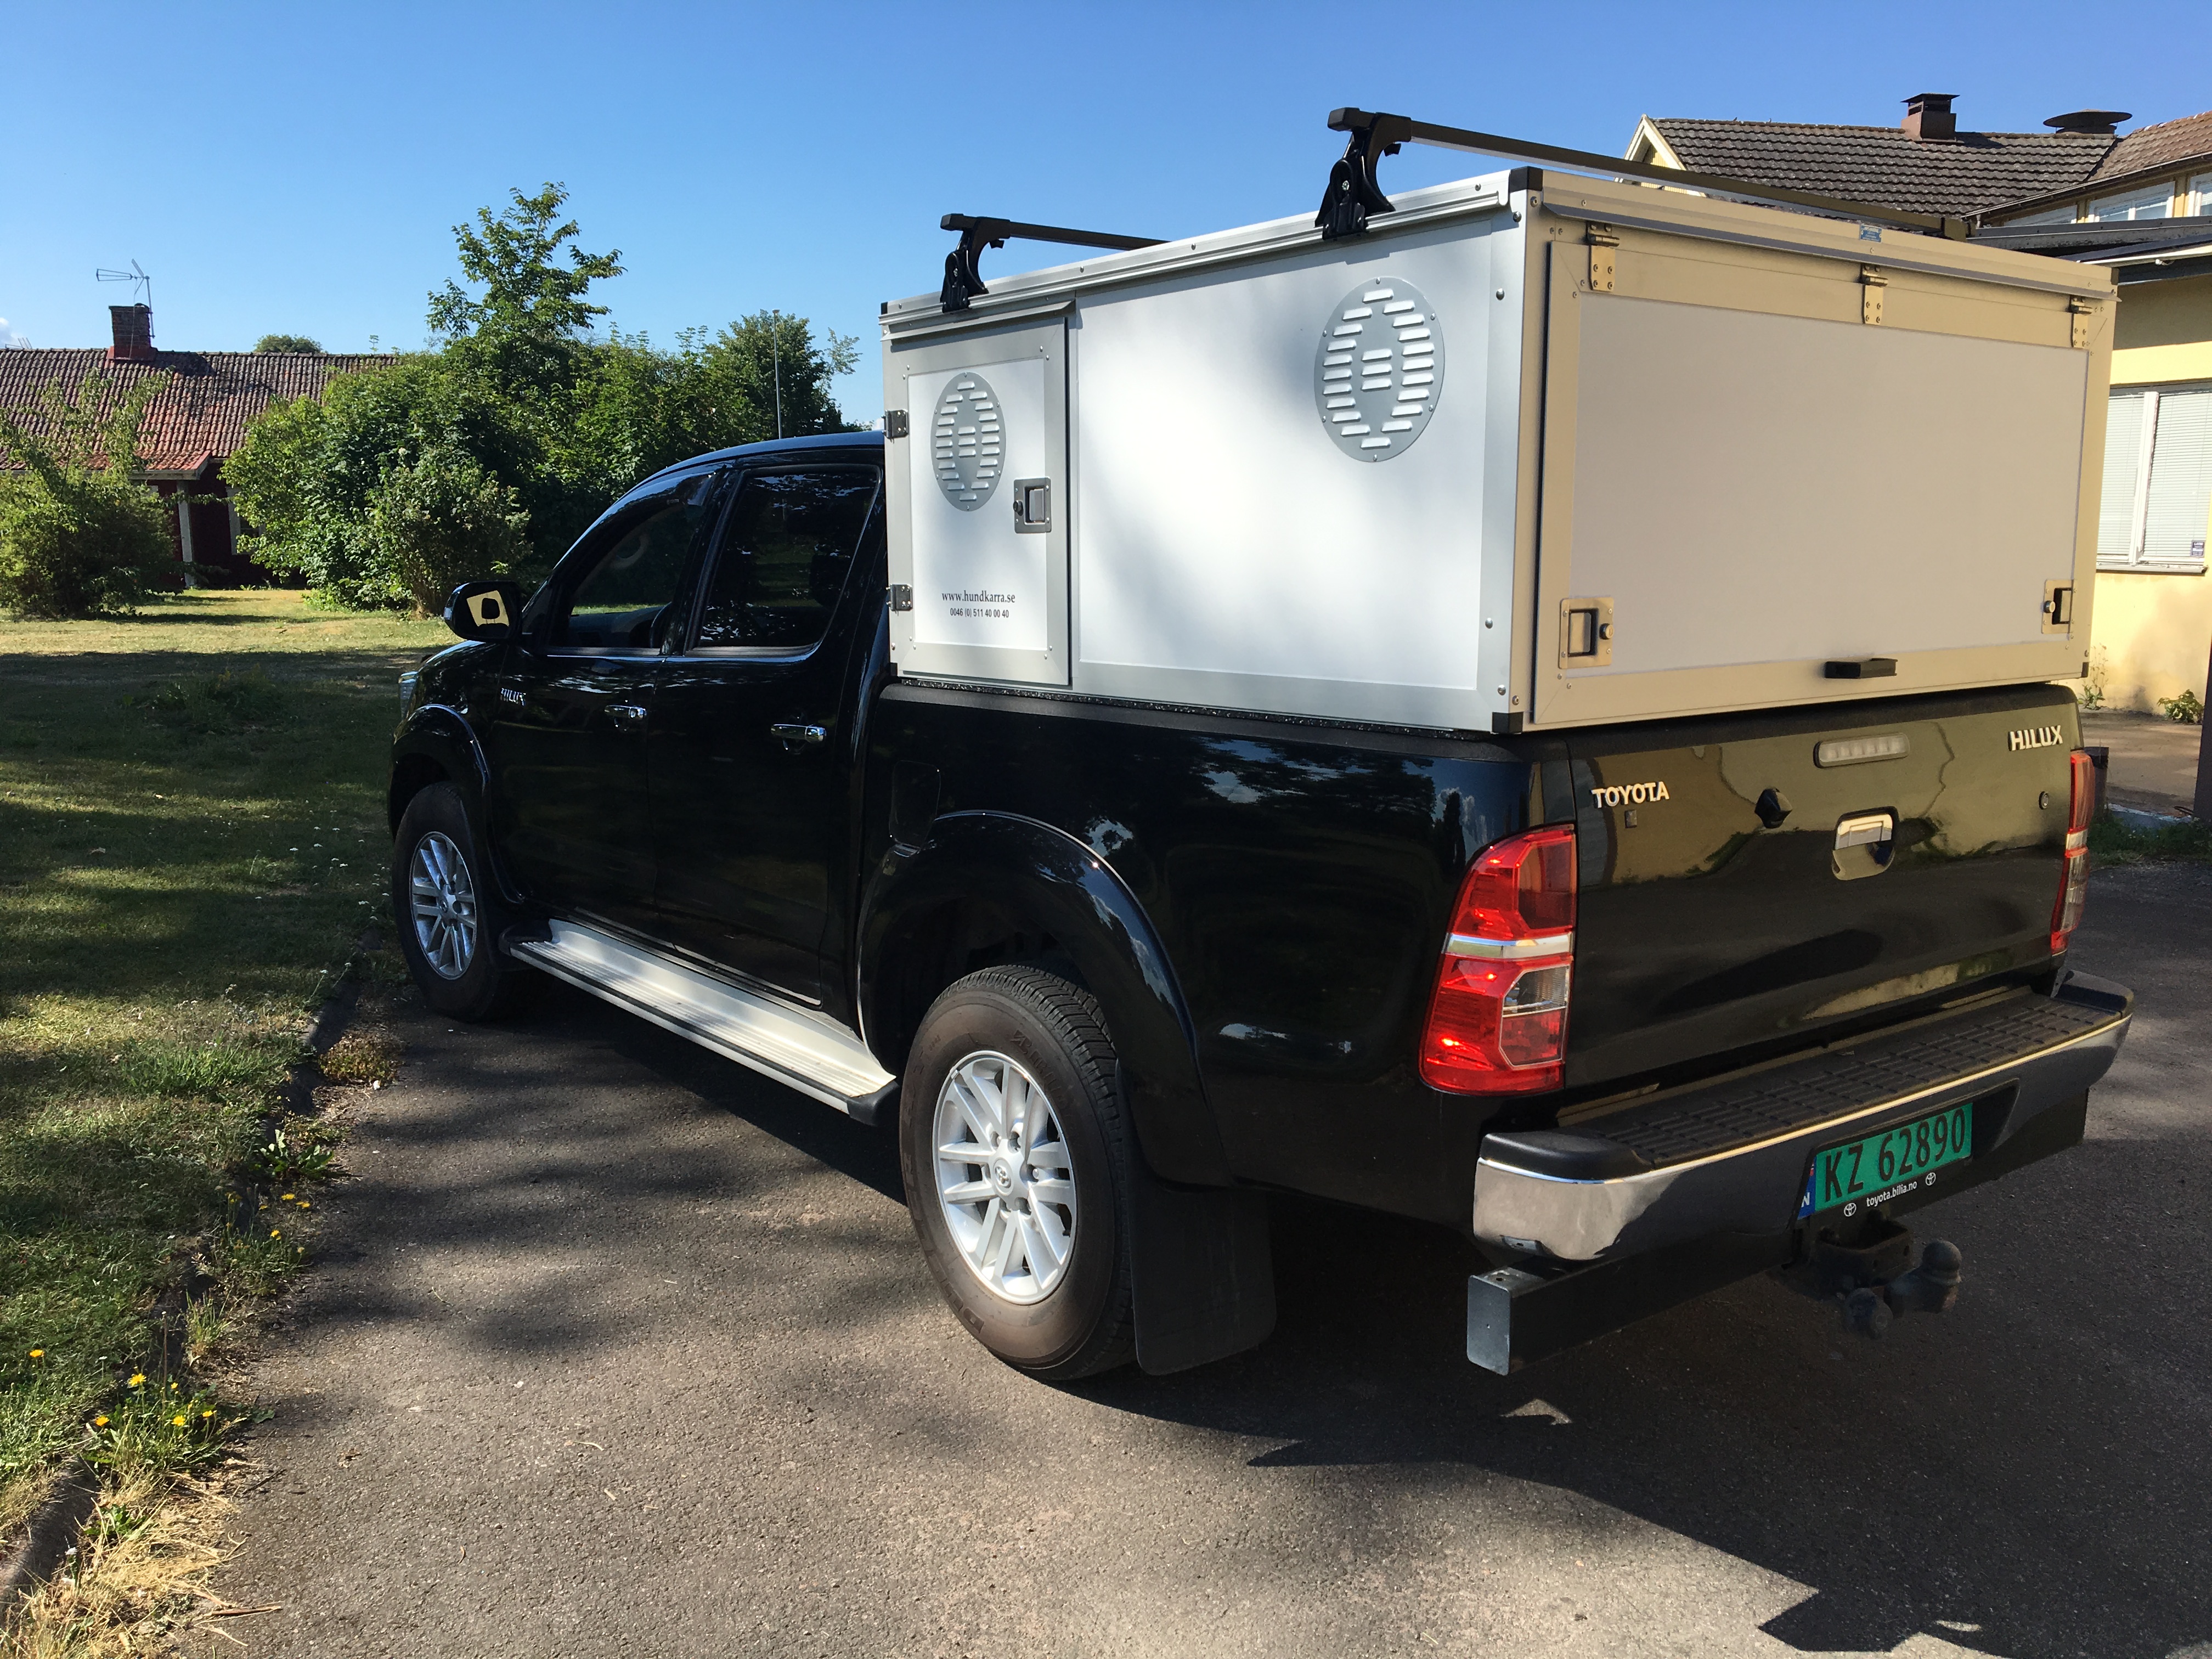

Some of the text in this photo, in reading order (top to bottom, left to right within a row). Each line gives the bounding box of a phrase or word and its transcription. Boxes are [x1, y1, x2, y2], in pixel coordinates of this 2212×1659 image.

[941, 590, 1015, 603] www.hundkarra.se
[950, 607, 963, 616] 0046
[973, 608, 983, 617] 511
[985, 608, 992, 618] 40
[994, 609, 1000, 618] 00
[1002, 610, 1009, 618] 40
[2009, 725, 2063, 751] HILUX
[1591, 781, 1670, 808] TOYOTA
[1825, 1108, 1965, 1202] KZ 62890
[1801, 1192, 1810, 1207] N
[1866, 1181, 1917, 1207] toyota.bilia.no
